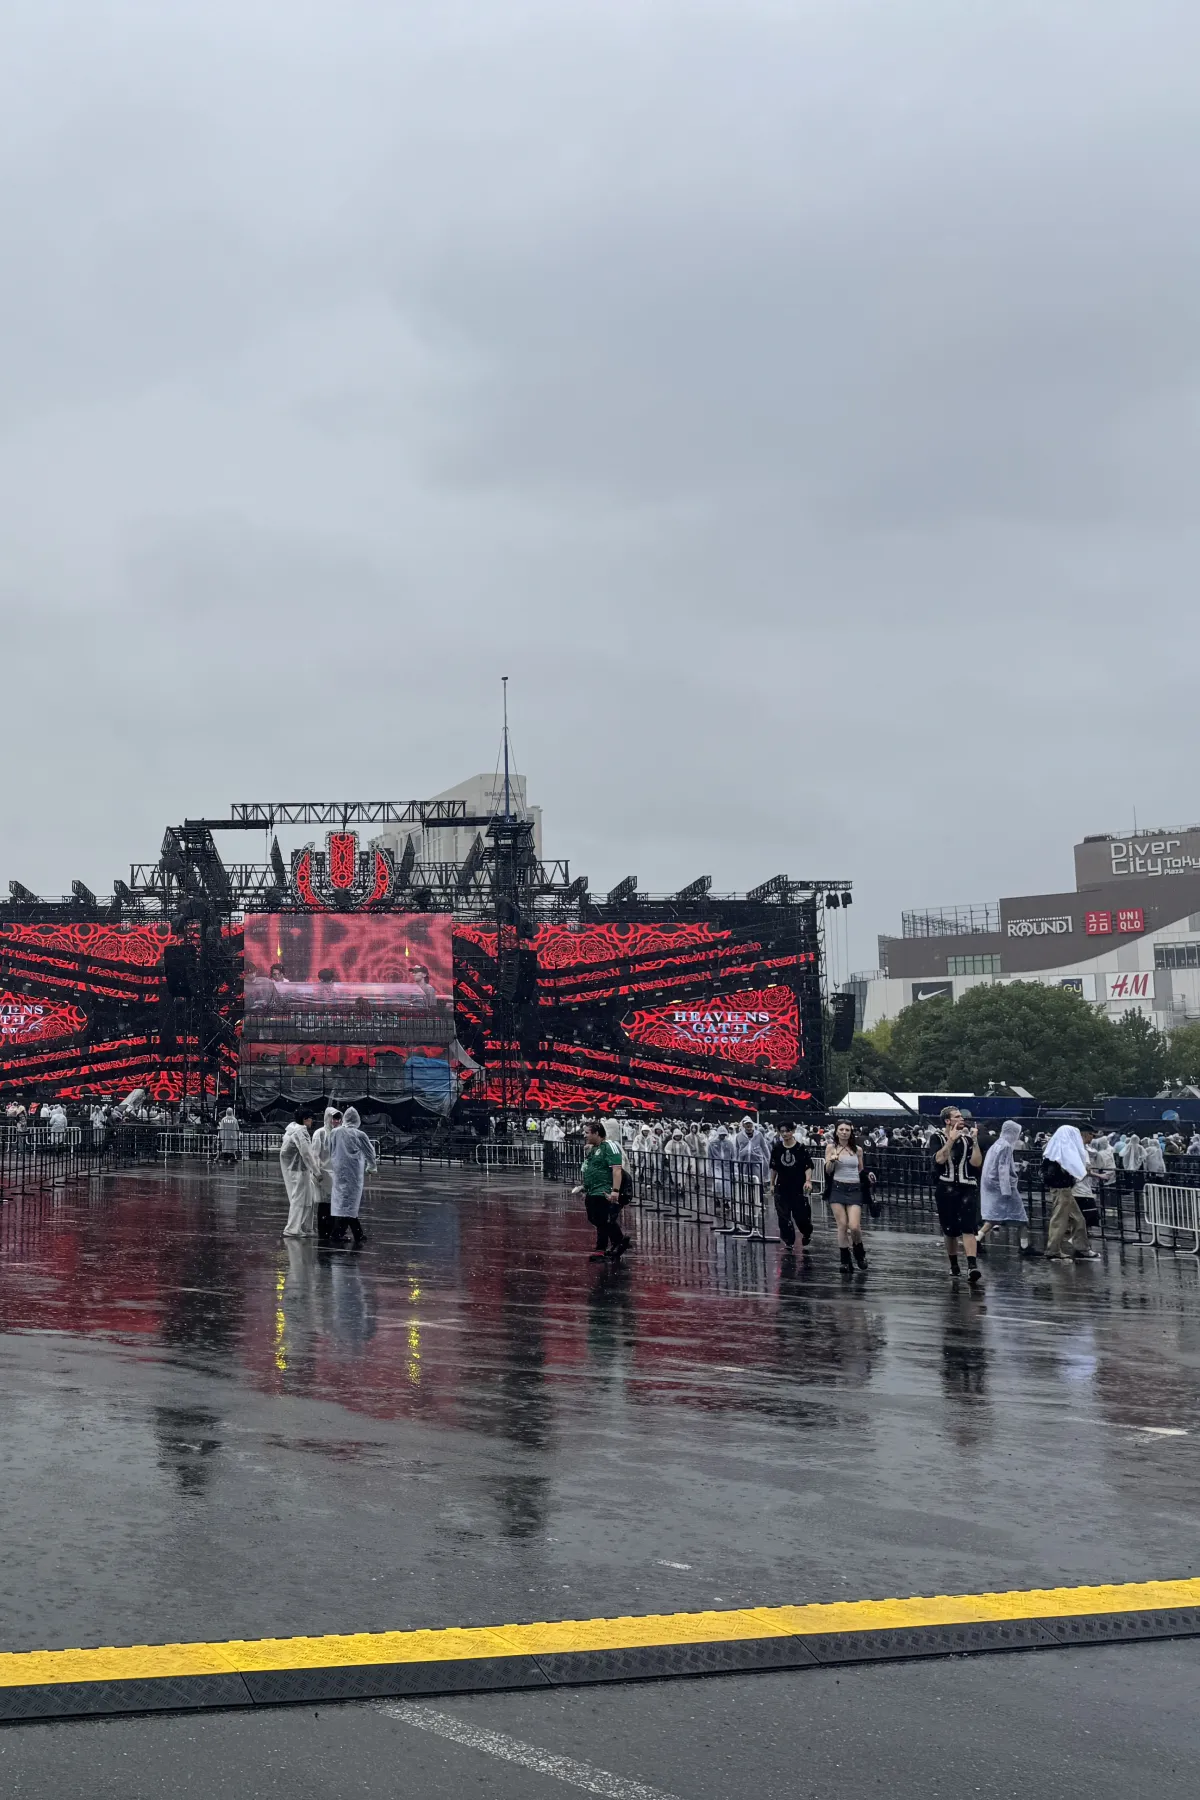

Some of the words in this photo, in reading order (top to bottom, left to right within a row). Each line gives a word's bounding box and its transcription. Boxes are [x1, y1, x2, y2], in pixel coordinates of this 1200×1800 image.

[1111, 840, 1180, 858] Diver
[1112, 857, 1162, 876] City
[1008, 916, 1072, 936] ROUND1
[1063, 983, 1082, 993] GU
[1111, 973, 1149, 997] H&M
[704, 1035, 741, 1043] crew
